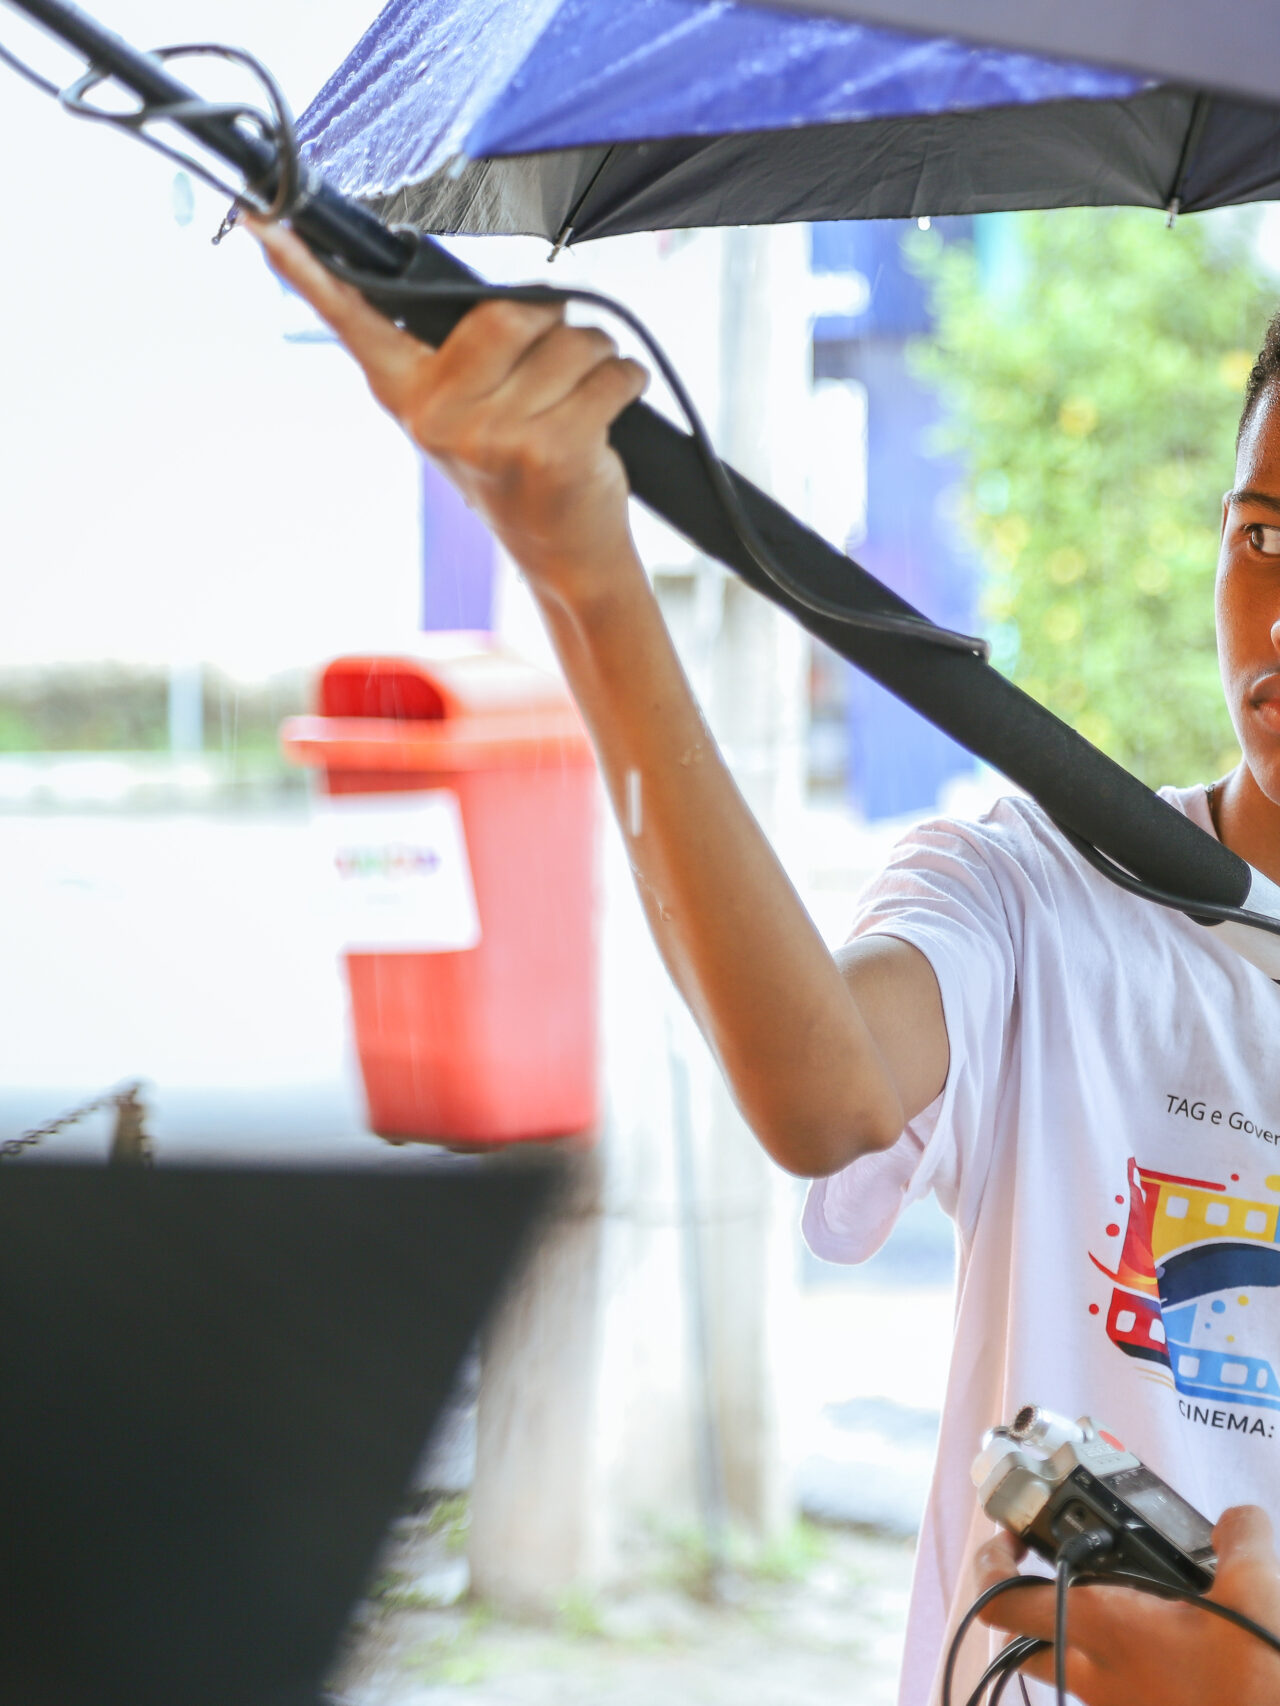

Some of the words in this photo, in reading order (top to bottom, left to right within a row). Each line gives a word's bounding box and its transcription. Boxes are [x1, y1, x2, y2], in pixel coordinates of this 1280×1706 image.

[1166, 1094, 1206, 1121] TAG
[1210, 1109, 1223, 1125] e
[1178, 1399, 1275, 1438] CINEMA:
